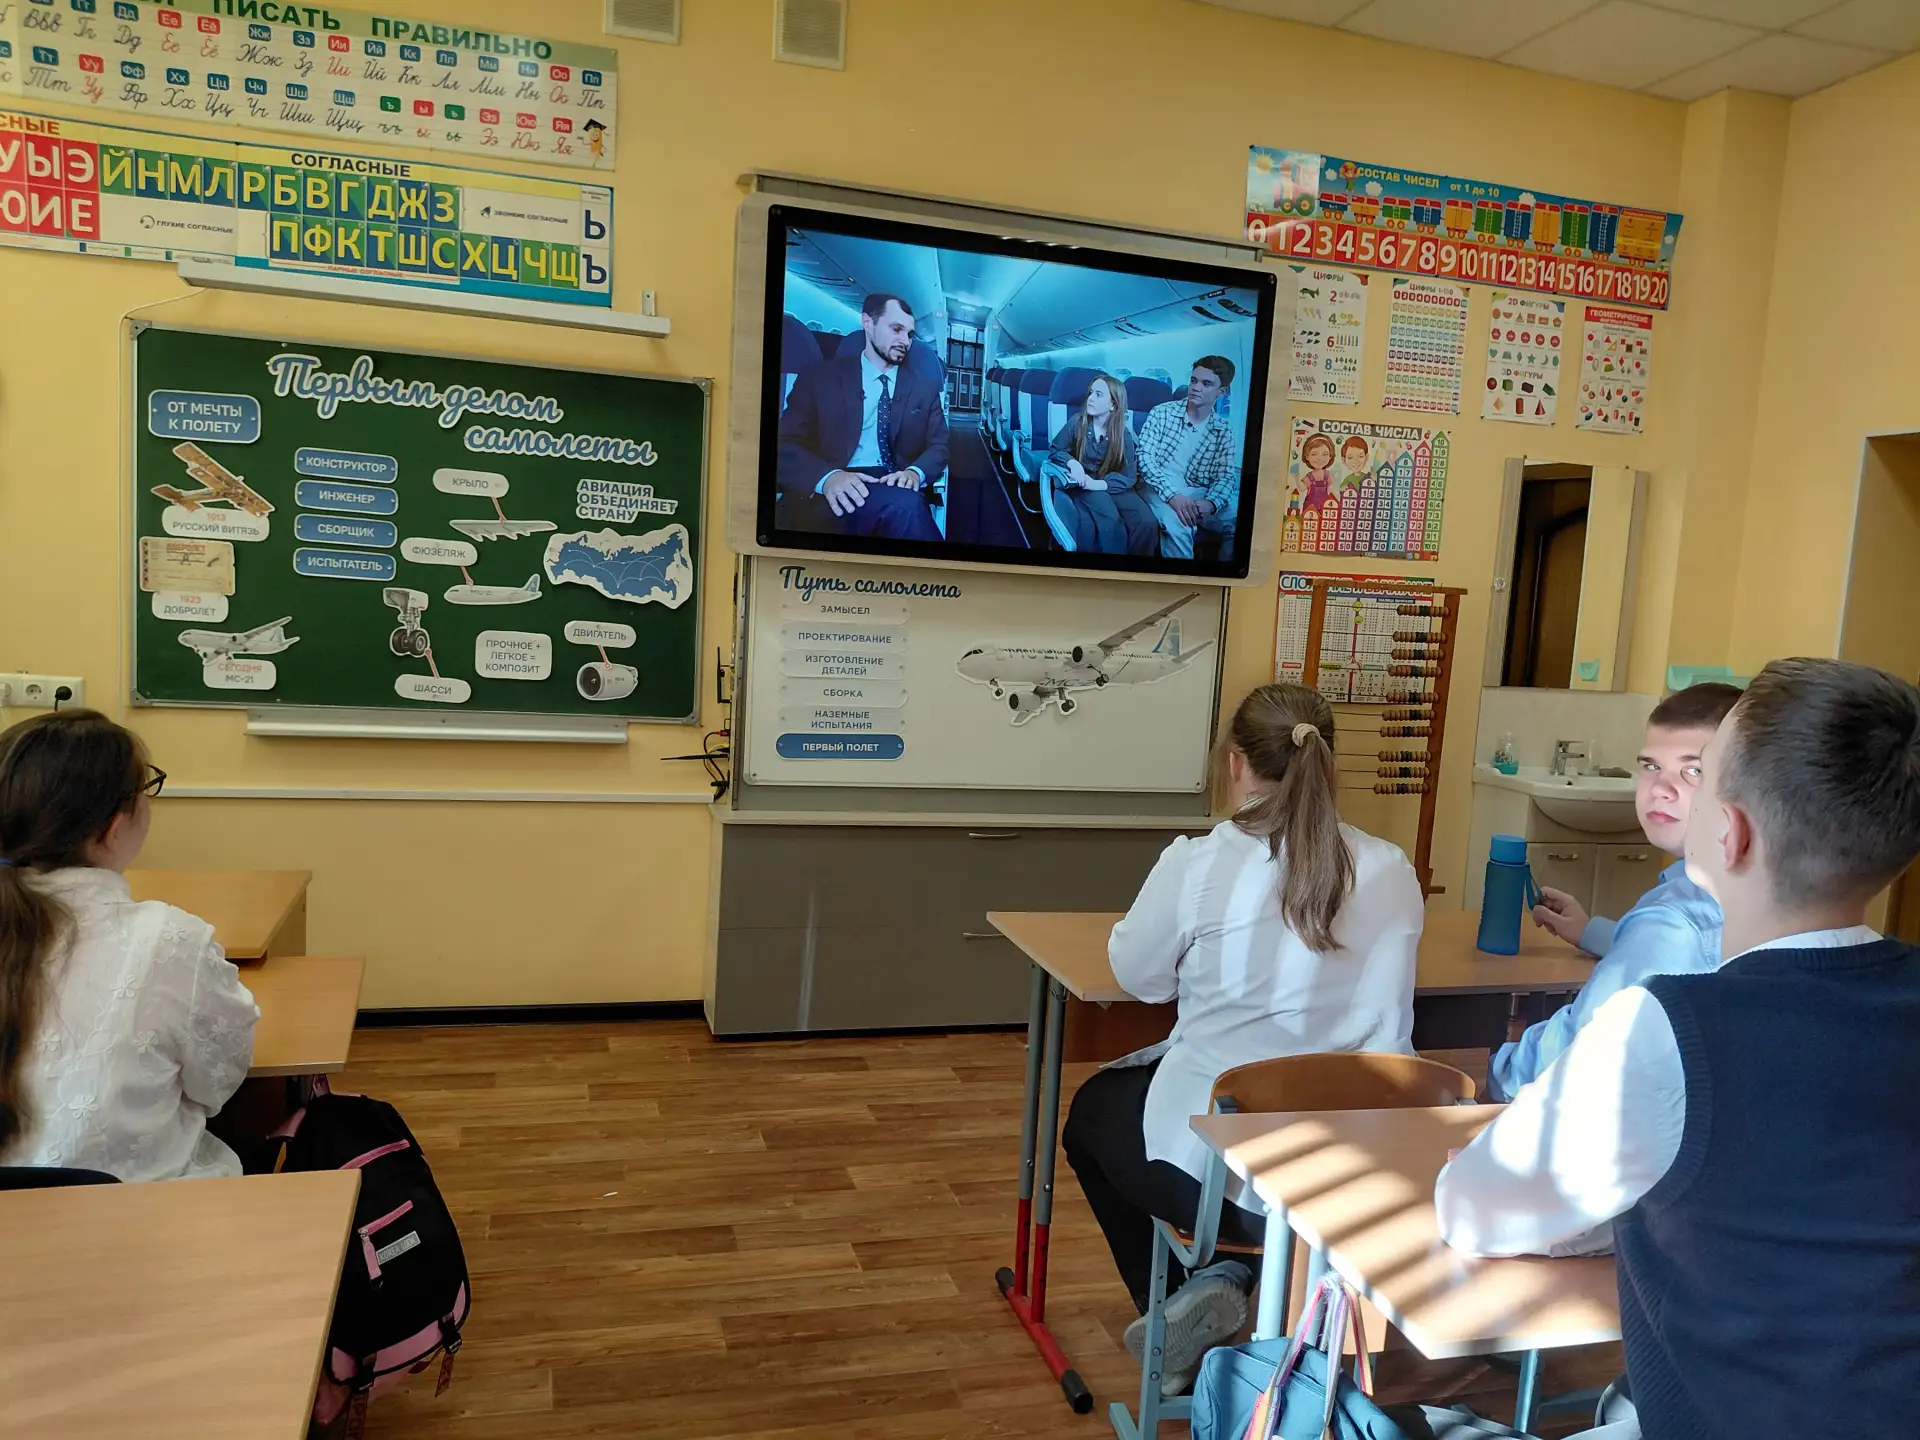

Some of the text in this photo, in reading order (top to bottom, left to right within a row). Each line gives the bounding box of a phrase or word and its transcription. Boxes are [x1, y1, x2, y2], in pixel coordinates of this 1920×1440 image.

[213, 0, 551, 59] ПИСАТЬ ПРАВИЛЬНО
[330, 39, 347, 51] Ии
[403, 48, 418, 59] Кк
[291, 152, 411, 178] СОГЛАСНЫЕ
[1357, 167, 1400, 182] СОСТАВ
[1404, 173, 1439, 188] ЧИСЕЛ
[1488, 188, 1499, 197] 10
[1275, 223, 1285, 250] 1
[1293, 224, 1312, 253] 2
[1316, 226, 1332, 255] 3
[1337, 230, 1354, 258] 4
[1358, 233, 1375, 261] 5
[1379, 236, 1395, 264] 6
[1400, 239, 1417, 267] 7
[1419, 242, 1435, 269] 8
[1441, 245, 1456, 272] 9
[1460, 248, 1477, 277] 10
[1480, 251, 1497, 279] 11
[1500, 254, 1517, 283] 12
[1519, 257, 1536, 285] 13
[1538, 259, 1555, 288] 14
[1558, 262, 1575, 290] 15
[1577, 265, 1594, 293] 16
[1597, 268, 1614, 296] 17
[1615, 271, 1632, 298] 18
[1634, 274, 1650, 301] 19
[1651, 277, 1667, 304] 20
[1313, 271, 1344, 282] ЦИФРЫ
[1409, 283, 1436, 292] ЦИФРЫ
[1330, 291, 1337, 302] 2
[1520, 300, 1549, 310] ФИГУРЫ
[1329, 313, 1337, 324] 4
[1327, 336, 1334, 347] 6
[1325, 359, 1332, 370] 8
[1502, 368, 1543, 380] 3D ФИГУРЫ
[271, 355, 562, 426] Первым делом
[1323, 382, 1337, 395] 10
[167, 401, 242, 417] ОТ МЕЧТЫ
[169, 419, 241, 433] К ПОЛЕТУ
[1322, 421, 1420, 439] СОСТАВ ЧИСЛА
[467, 428, 655, 463] самолеты
[306, 457, 387, 472] КОНСТРУКТОР
[452, 478, 489, 489] КРЫЛО
[579, 481, 651, 497] АВИАЦИЯ
[319, 490, 375, 503] ИНЖЕНЕР
[579, 494, 676, 512] ОБЪЕДИНЯЕТ
[579, 507, 636, 521] СТРАНУ
[173, 521, 259, 536] РУССКИЙ ВИТЯЗЬ
[318, 524, 374, 537] СБОРЩИК
[412, 545, 466, 560] ФЮЗЕЛЯЖ
[308, 557, 382, 571] ИСПЫТАТЕЛЬ
[779, 566, 962, 602] Путь самолета
[180, 595, 201, 603] 1923
[821, 605, 870, 614] ЗАМЫСЕЛ
[573, 628, 626, 640] ДВИГАТЕЛЬ
[798, 632, 891, 644] ПРОЕКТИРОВАНИЕ
[486, 640, 532, 650] ПРОЧНОЕ
[805, 655, 883, 665] ИЗГОТОВЛЕНИЕ
[218, 663, 262, 673] СЕГОДНЯ
[485, 664, 540, 674] КОМПОЗИТ
[821, 666, 867, 675] ДЕТАЛЕЙ
[226, 674, 254, 684] МС-21
[414, 684, 452, 695] ШАССИ
[823, 689, 863, 698] СБОРКА
[815, 710, 870, 719] НАЗЕМНЫЕ
[811, 721, 872, 730] ИСПЫТАНИЯ
[803, 741, 879, 751] ПЕРВЫЙ ПОЛЕТ
